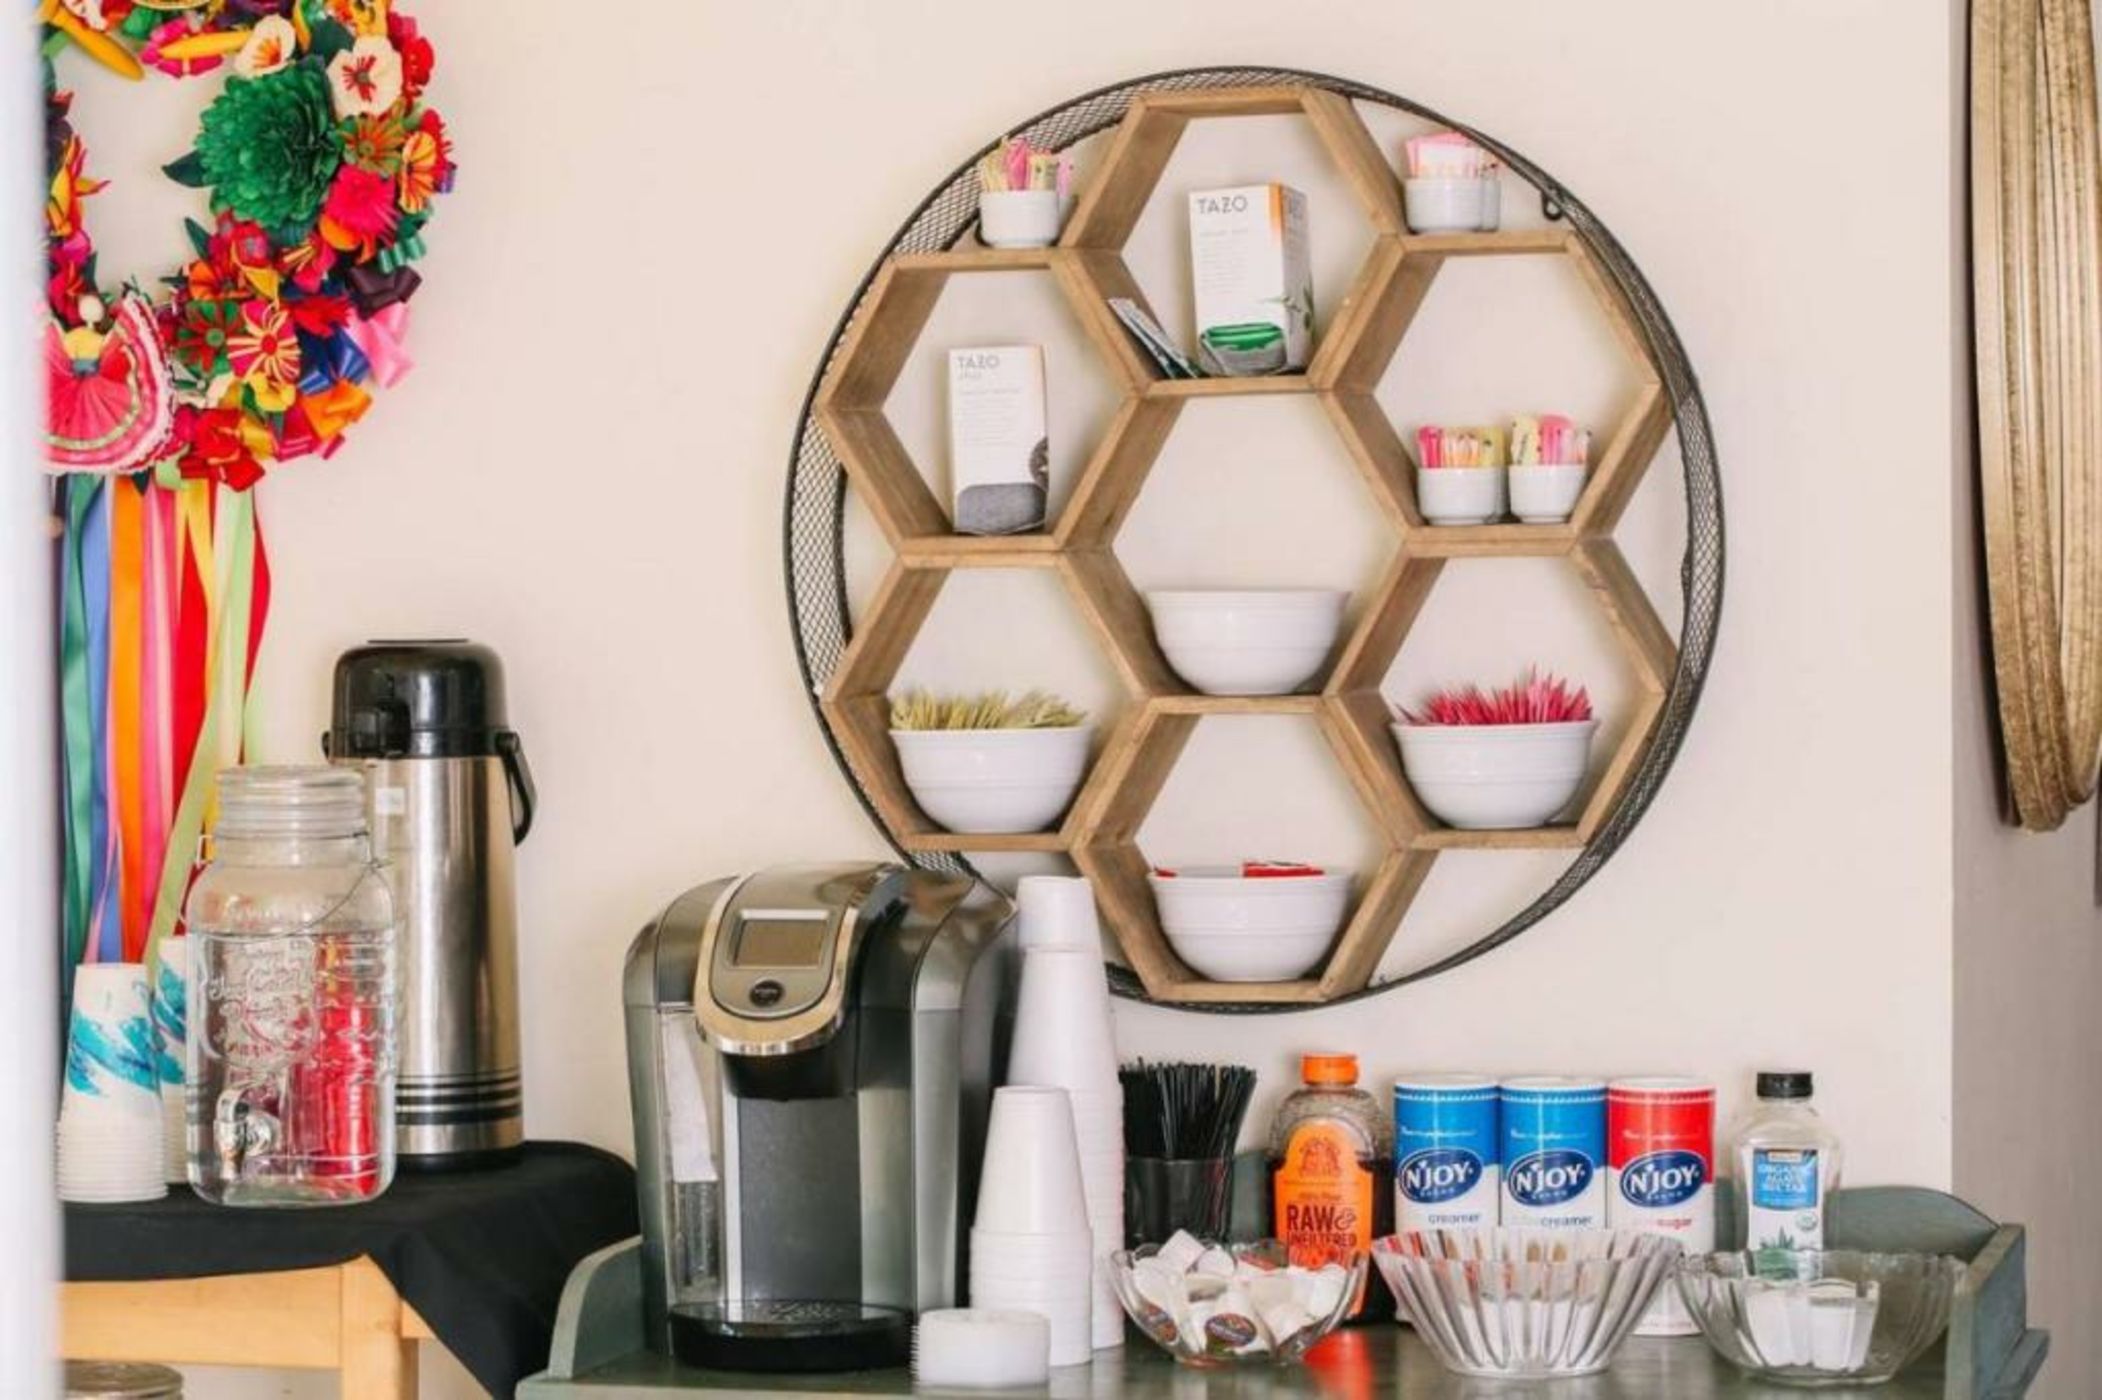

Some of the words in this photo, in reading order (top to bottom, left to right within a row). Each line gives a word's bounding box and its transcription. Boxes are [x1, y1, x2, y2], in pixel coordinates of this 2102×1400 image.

[1197, 195, 1249, 215] TAZO
[957, 353, 1001, 371] TAZO
[1286, 1204, 1335, 1232] RAW
[1428, 1212, 1481, 1225] creamer
[1540, 1215, 1593, 1227] creamer
[1657, 1218, 1692, 1230] sugar
